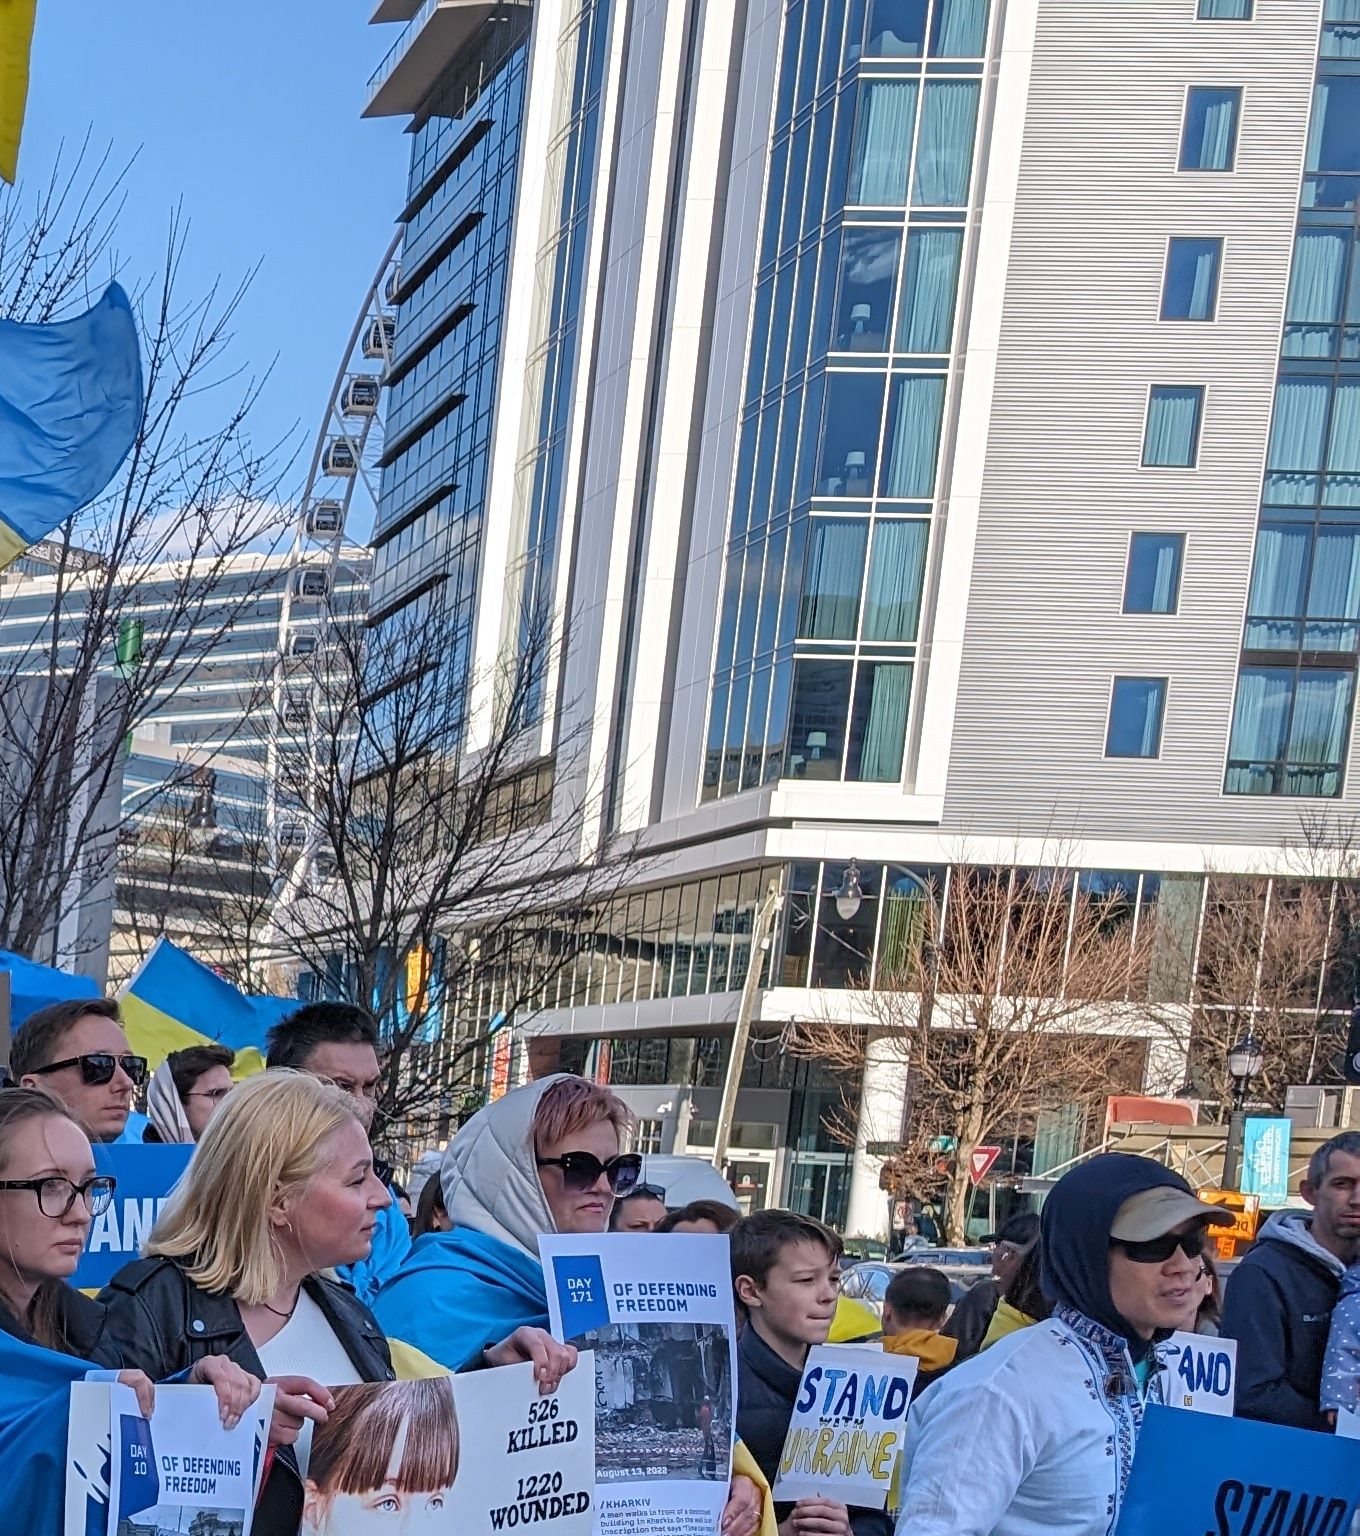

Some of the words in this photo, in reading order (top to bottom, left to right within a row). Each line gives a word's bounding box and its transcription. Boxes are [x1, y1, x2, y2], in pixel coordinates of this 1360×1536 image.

[567, 1278, 592, 1289] DAY
[613, 1283, 633, 1296] OF
[638, 1283, 717, 1297] DEFENDING
[570, 1291, 593, 1302] 171
[616, 1299, 688, 1312] FREEDOM
[1178, 1345, 1231, 1396] AND
[797, 1367, 908, 1420] STAND
[528, 1399, 559, 1424] 526
[819, 1416, 864, 1429] WITH
[507, 1420, 578, 1454] KILLED
[131, 1444, 146, 1458] DAY
[780, 1428, 897, 1479] UKRAINE
[134, 1462, 146, 1474] 10
[162, 1456, 179, 1472] OF
[183, 1457, 240, 1476] DEFENDING
[597, 1468, 630, 1478] August
[165, 1476, 216, 1494] FREEDOM
[516, 1471, 562, 1501] 1220
[600, 1498, 650, 1509] /KHARKIV
[490, 1491, 590, 1531] WOUNDED
[601, 1518, 634, 1527] building
[601, 1527, 649, 1535] inscription
